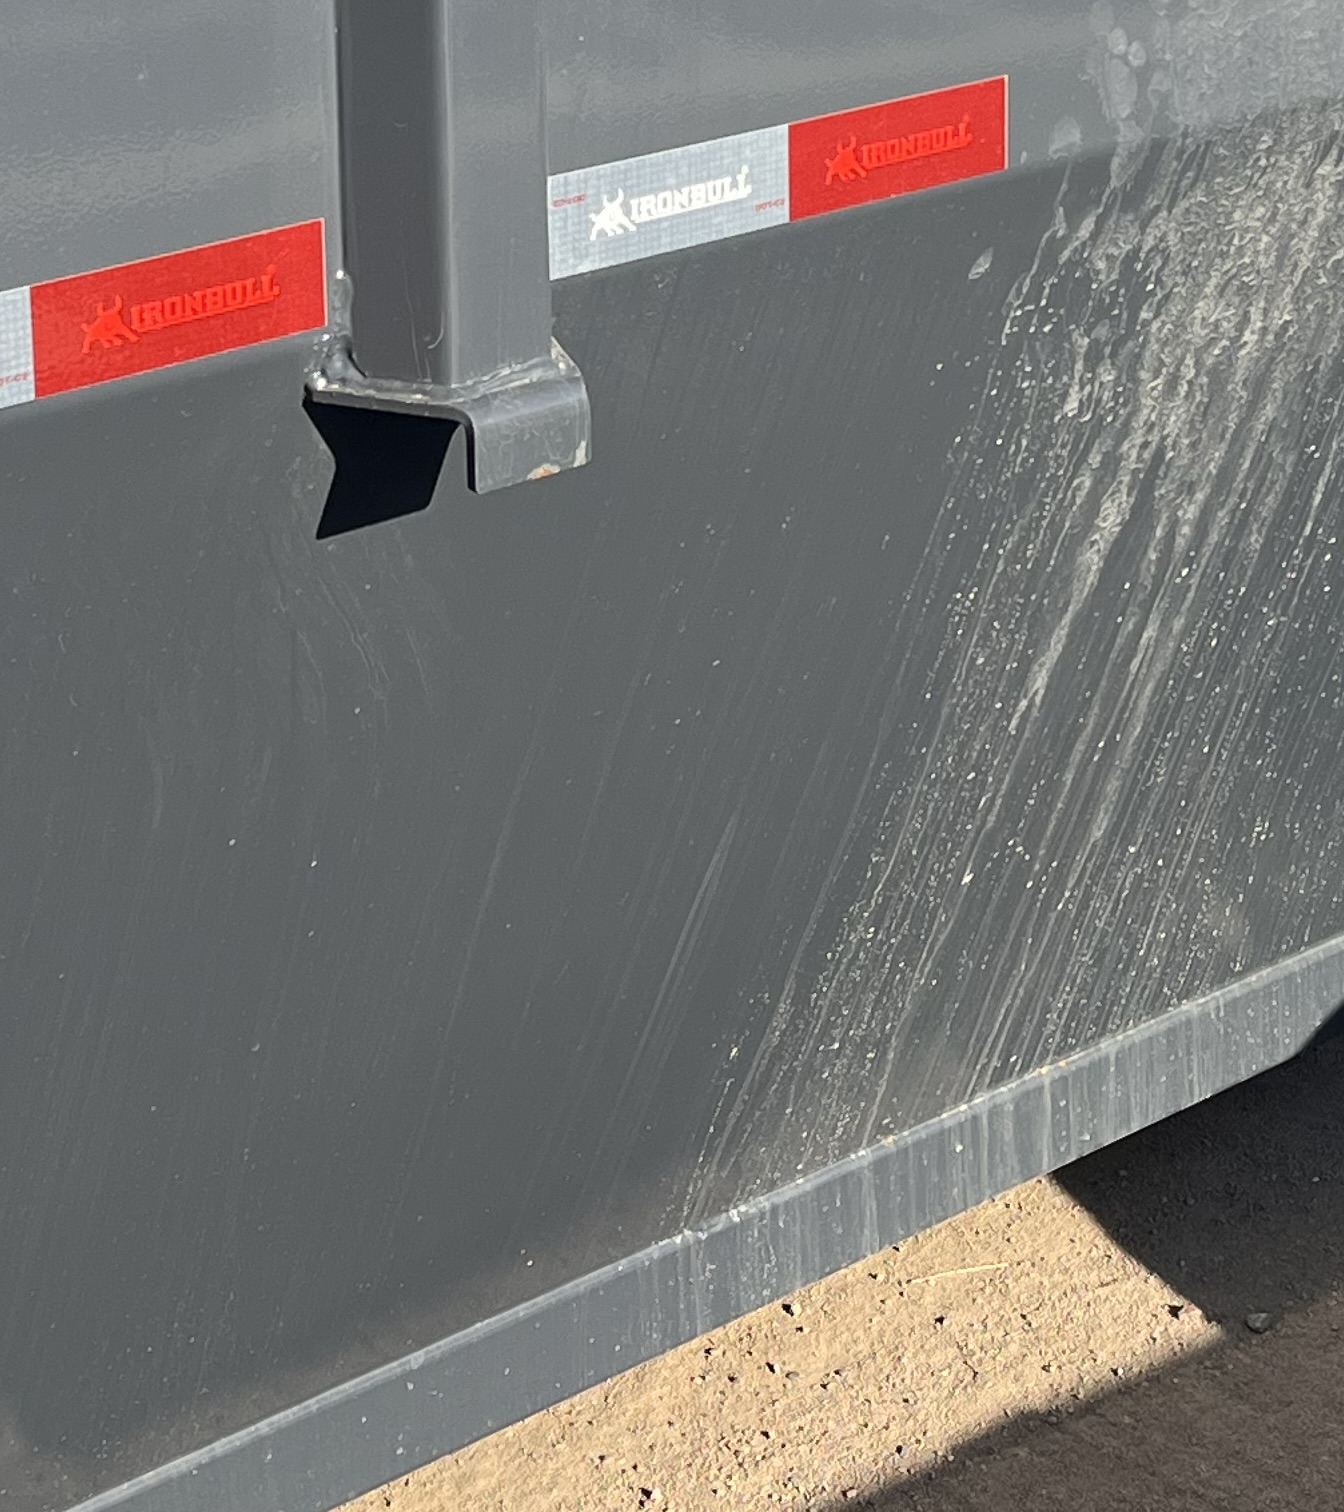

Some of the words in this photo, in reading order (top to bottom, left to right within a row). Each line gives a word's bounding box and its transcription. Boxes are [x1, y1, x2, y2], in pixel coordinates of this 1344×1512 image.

[861, 114, 973, 170] IRONBULL
[629, 165, 752, 223] IRONBULL
[130, 264, 281, 332] IRONBULL
